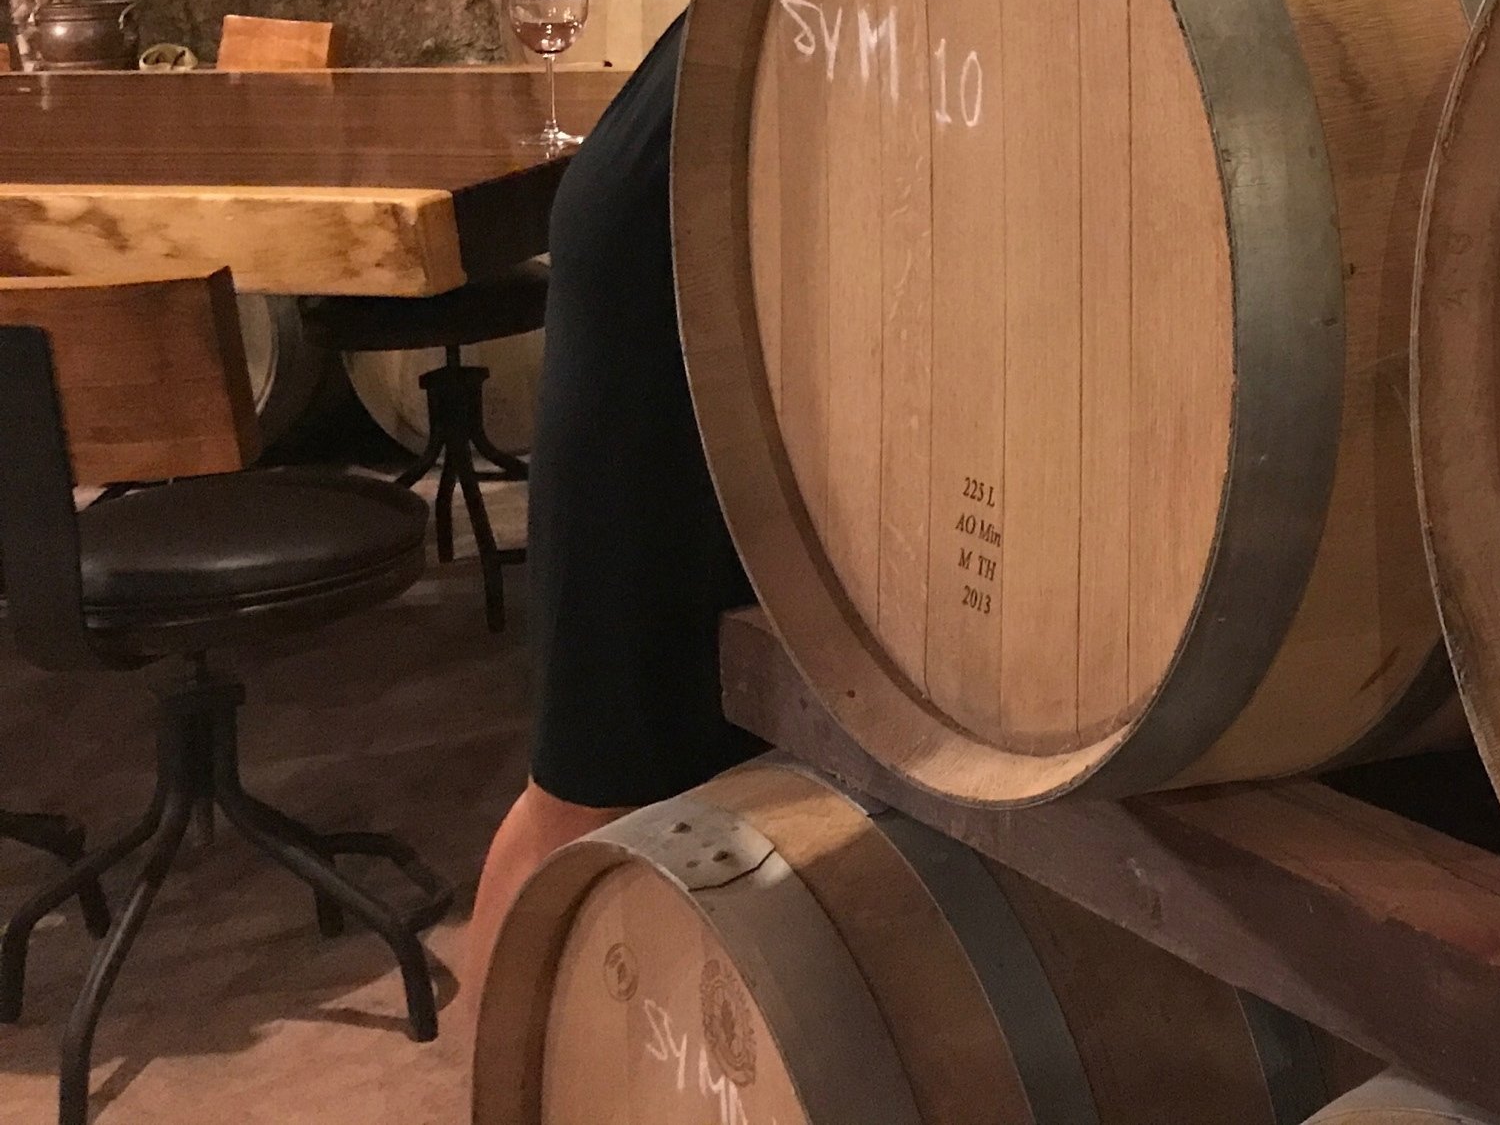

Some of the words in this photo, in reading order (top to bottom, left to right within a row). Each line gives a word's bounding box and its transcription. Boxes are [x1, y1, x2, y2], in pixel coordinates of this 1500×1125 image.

[962, 477, 985, 501] 225
[986, 486, 996, 507] L
[978, 519, 1002, 547] Min
[958, 547, 973, 569] M
[978, 555, 997, 581] TH
[961, 585, 992, 614] 2013
